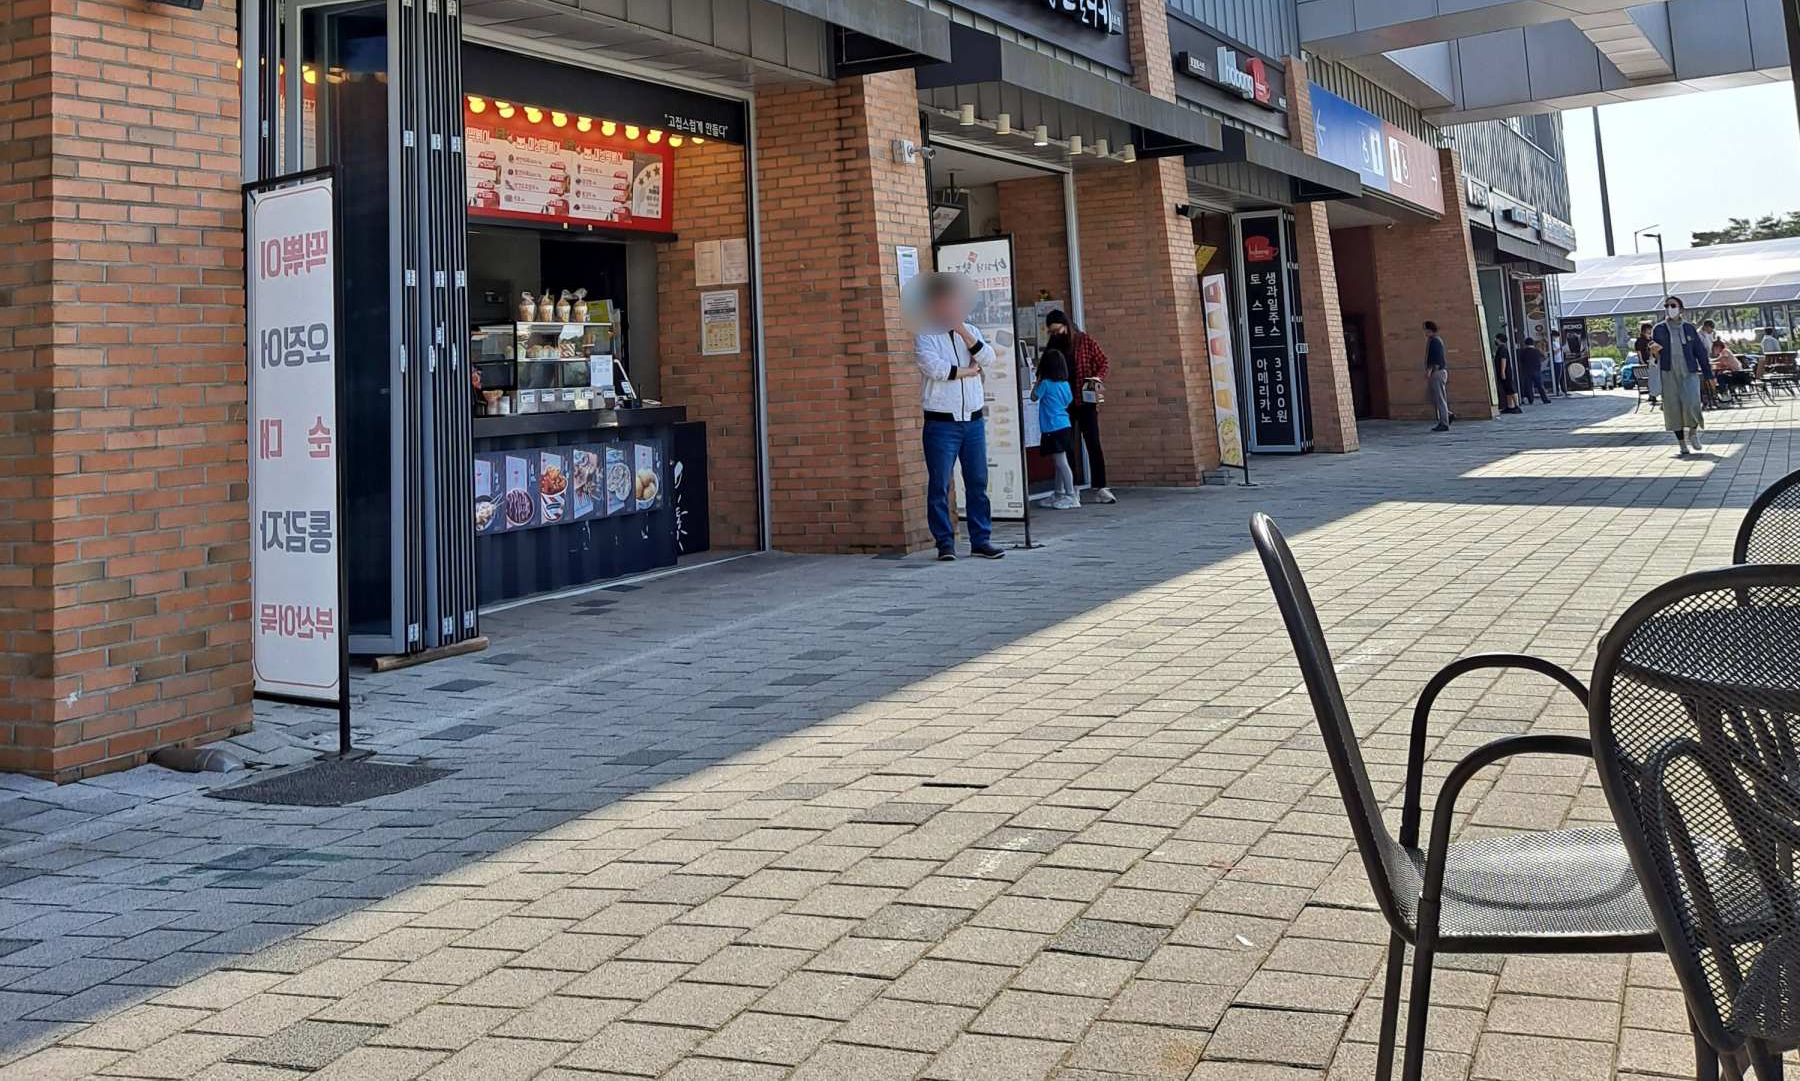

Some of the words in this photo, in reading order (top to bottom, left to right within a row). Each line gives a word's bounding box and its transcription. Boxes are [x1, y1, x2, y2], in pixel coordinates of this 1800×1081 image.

[1249, 273, 1266, 337] 토스트
[1265, 271, 1281, 336] 생과일주스
[1256, 357, 1272, 424] 아메리카노
[1274, 357, 1288, 423] 3300원
